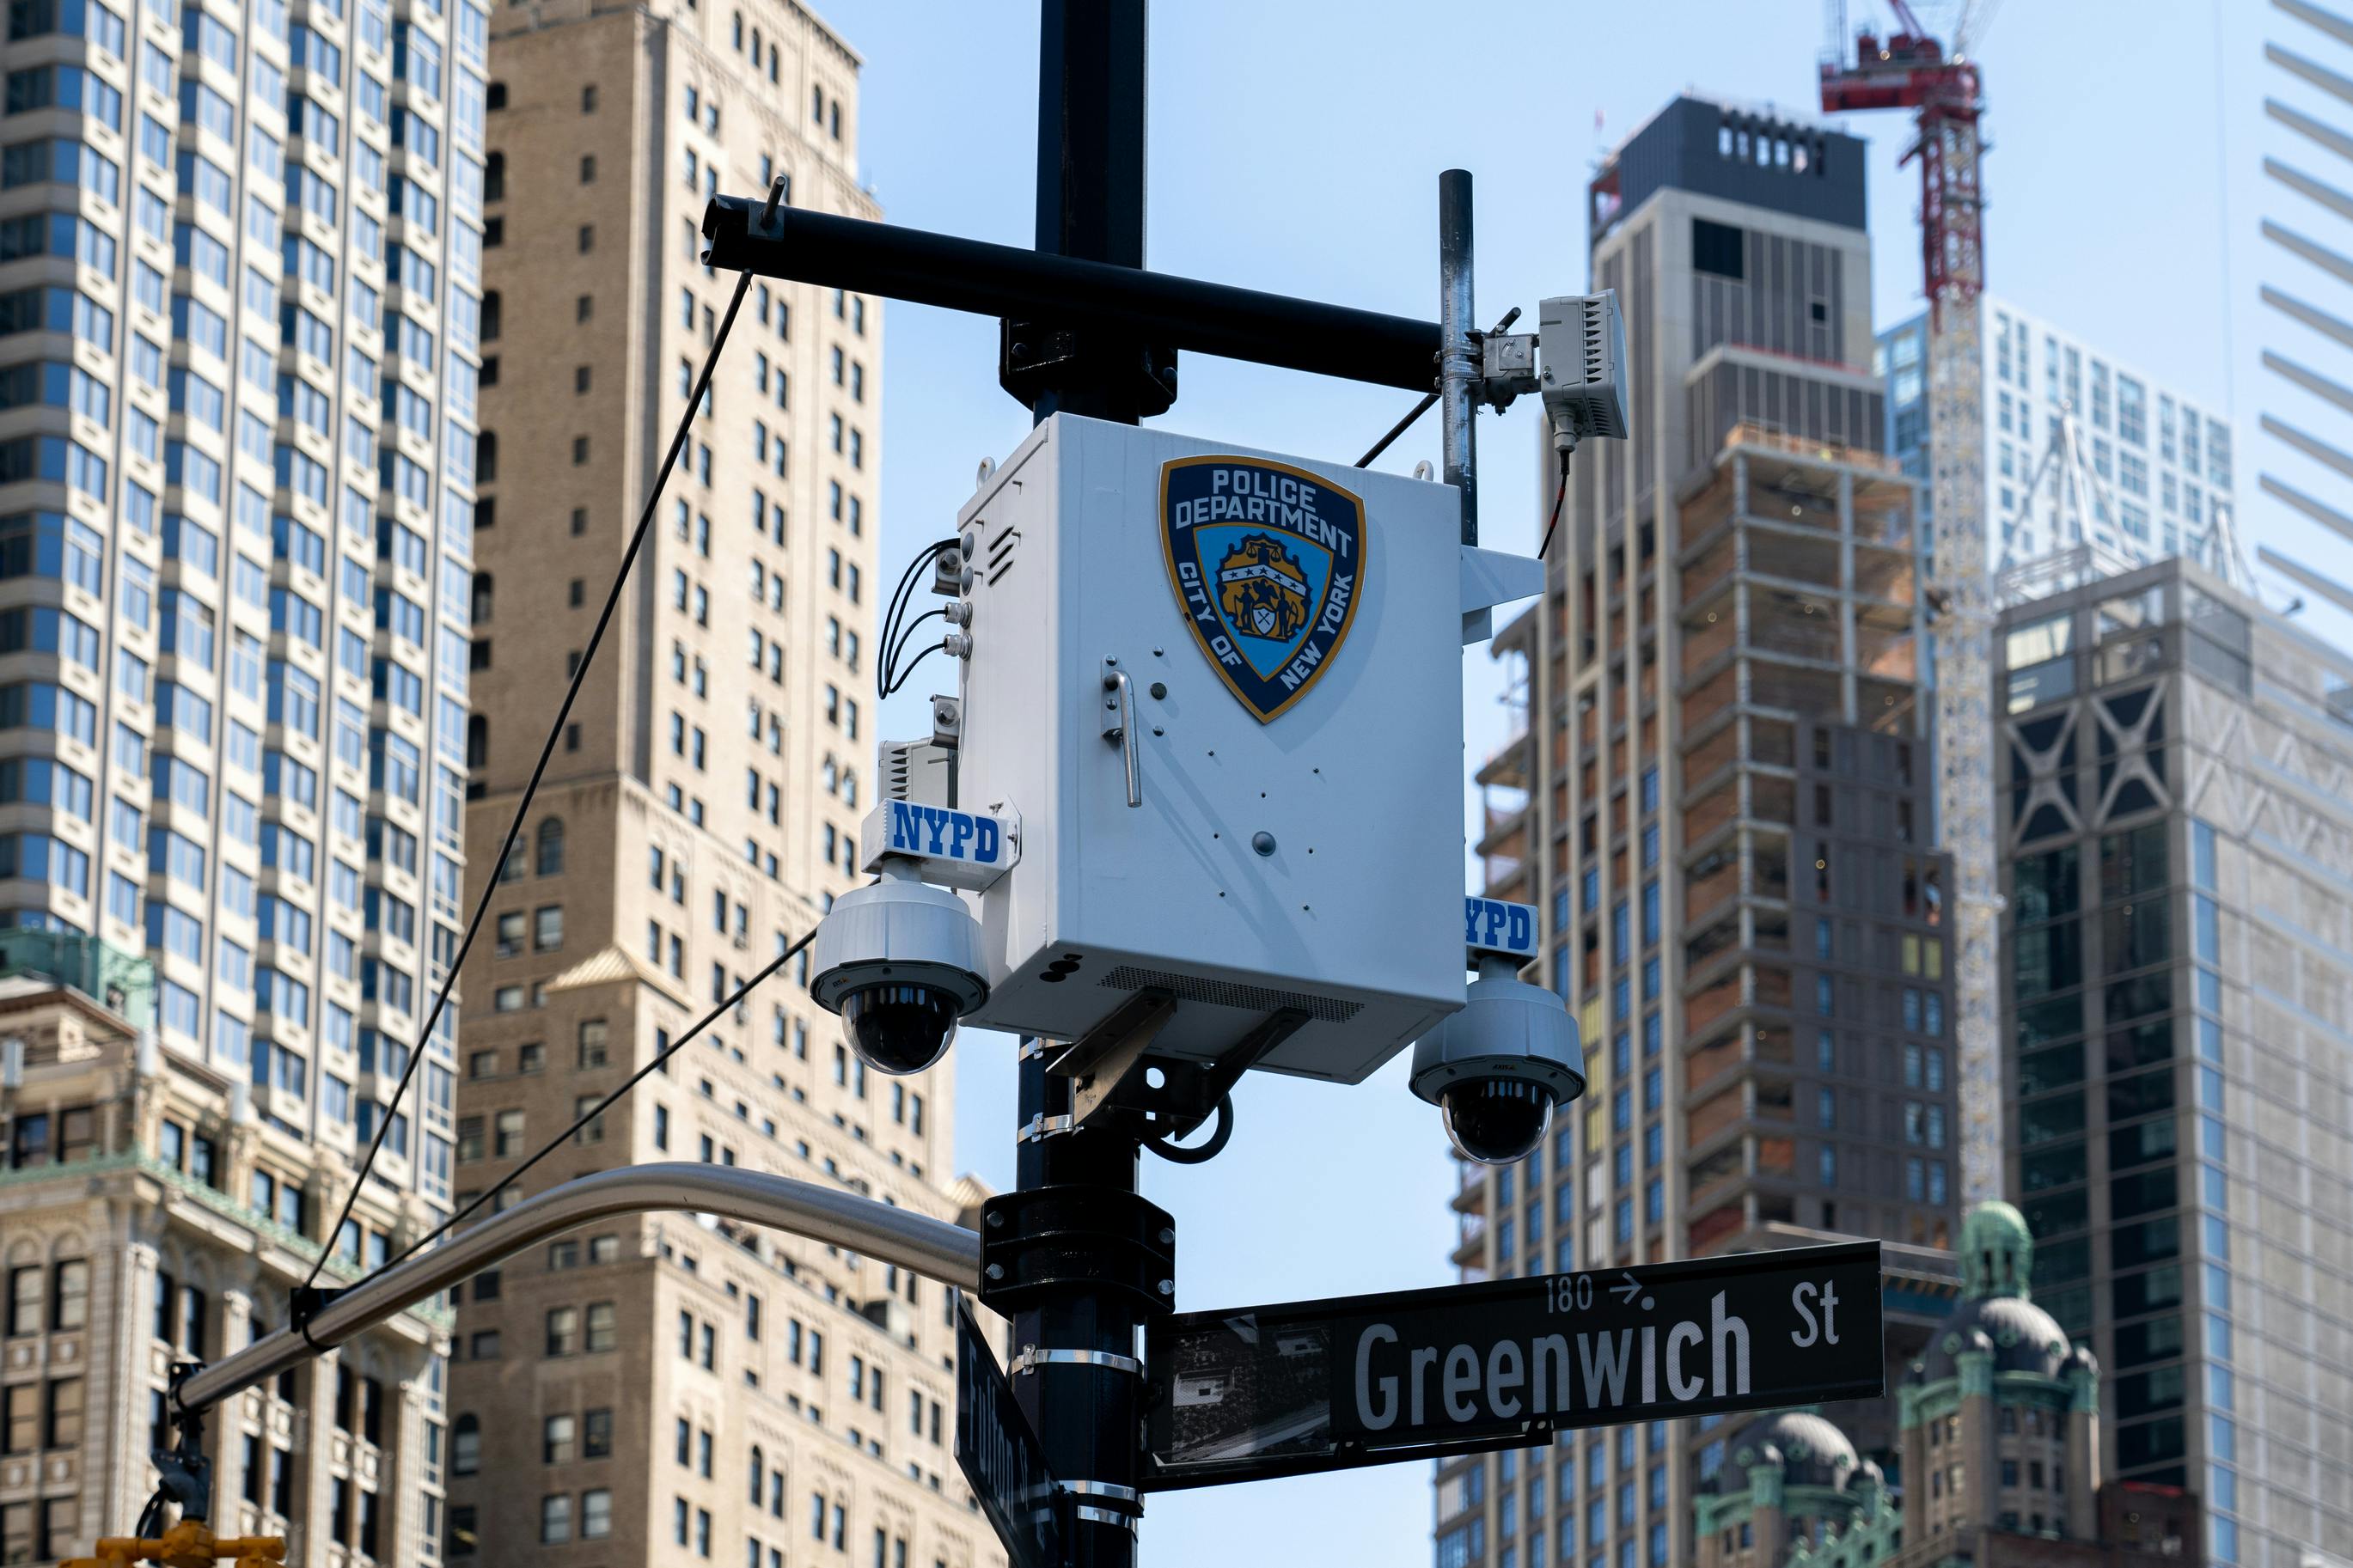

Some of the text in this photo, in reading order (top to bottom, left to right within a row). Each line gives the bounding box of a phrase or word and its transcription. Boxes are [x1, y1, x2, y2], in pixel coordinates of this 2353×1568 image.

[1213, 469, 1317, 513] POLICE
[1176, 495, 1352, 558] DEPARTMENT
[1179, 562, 1242, 668] CITY OF
[1280, 572, 1353, 691] NEW YORK
[893, 802, 999, 863] NYPD
[1465, 898, 1530, 950] YPD
[1546, 1273, 1593, 1314] 180
[1355, 1278, 1840, 1431] Greenwich St
[969, 1337, 1029, 1528] Fulton St
